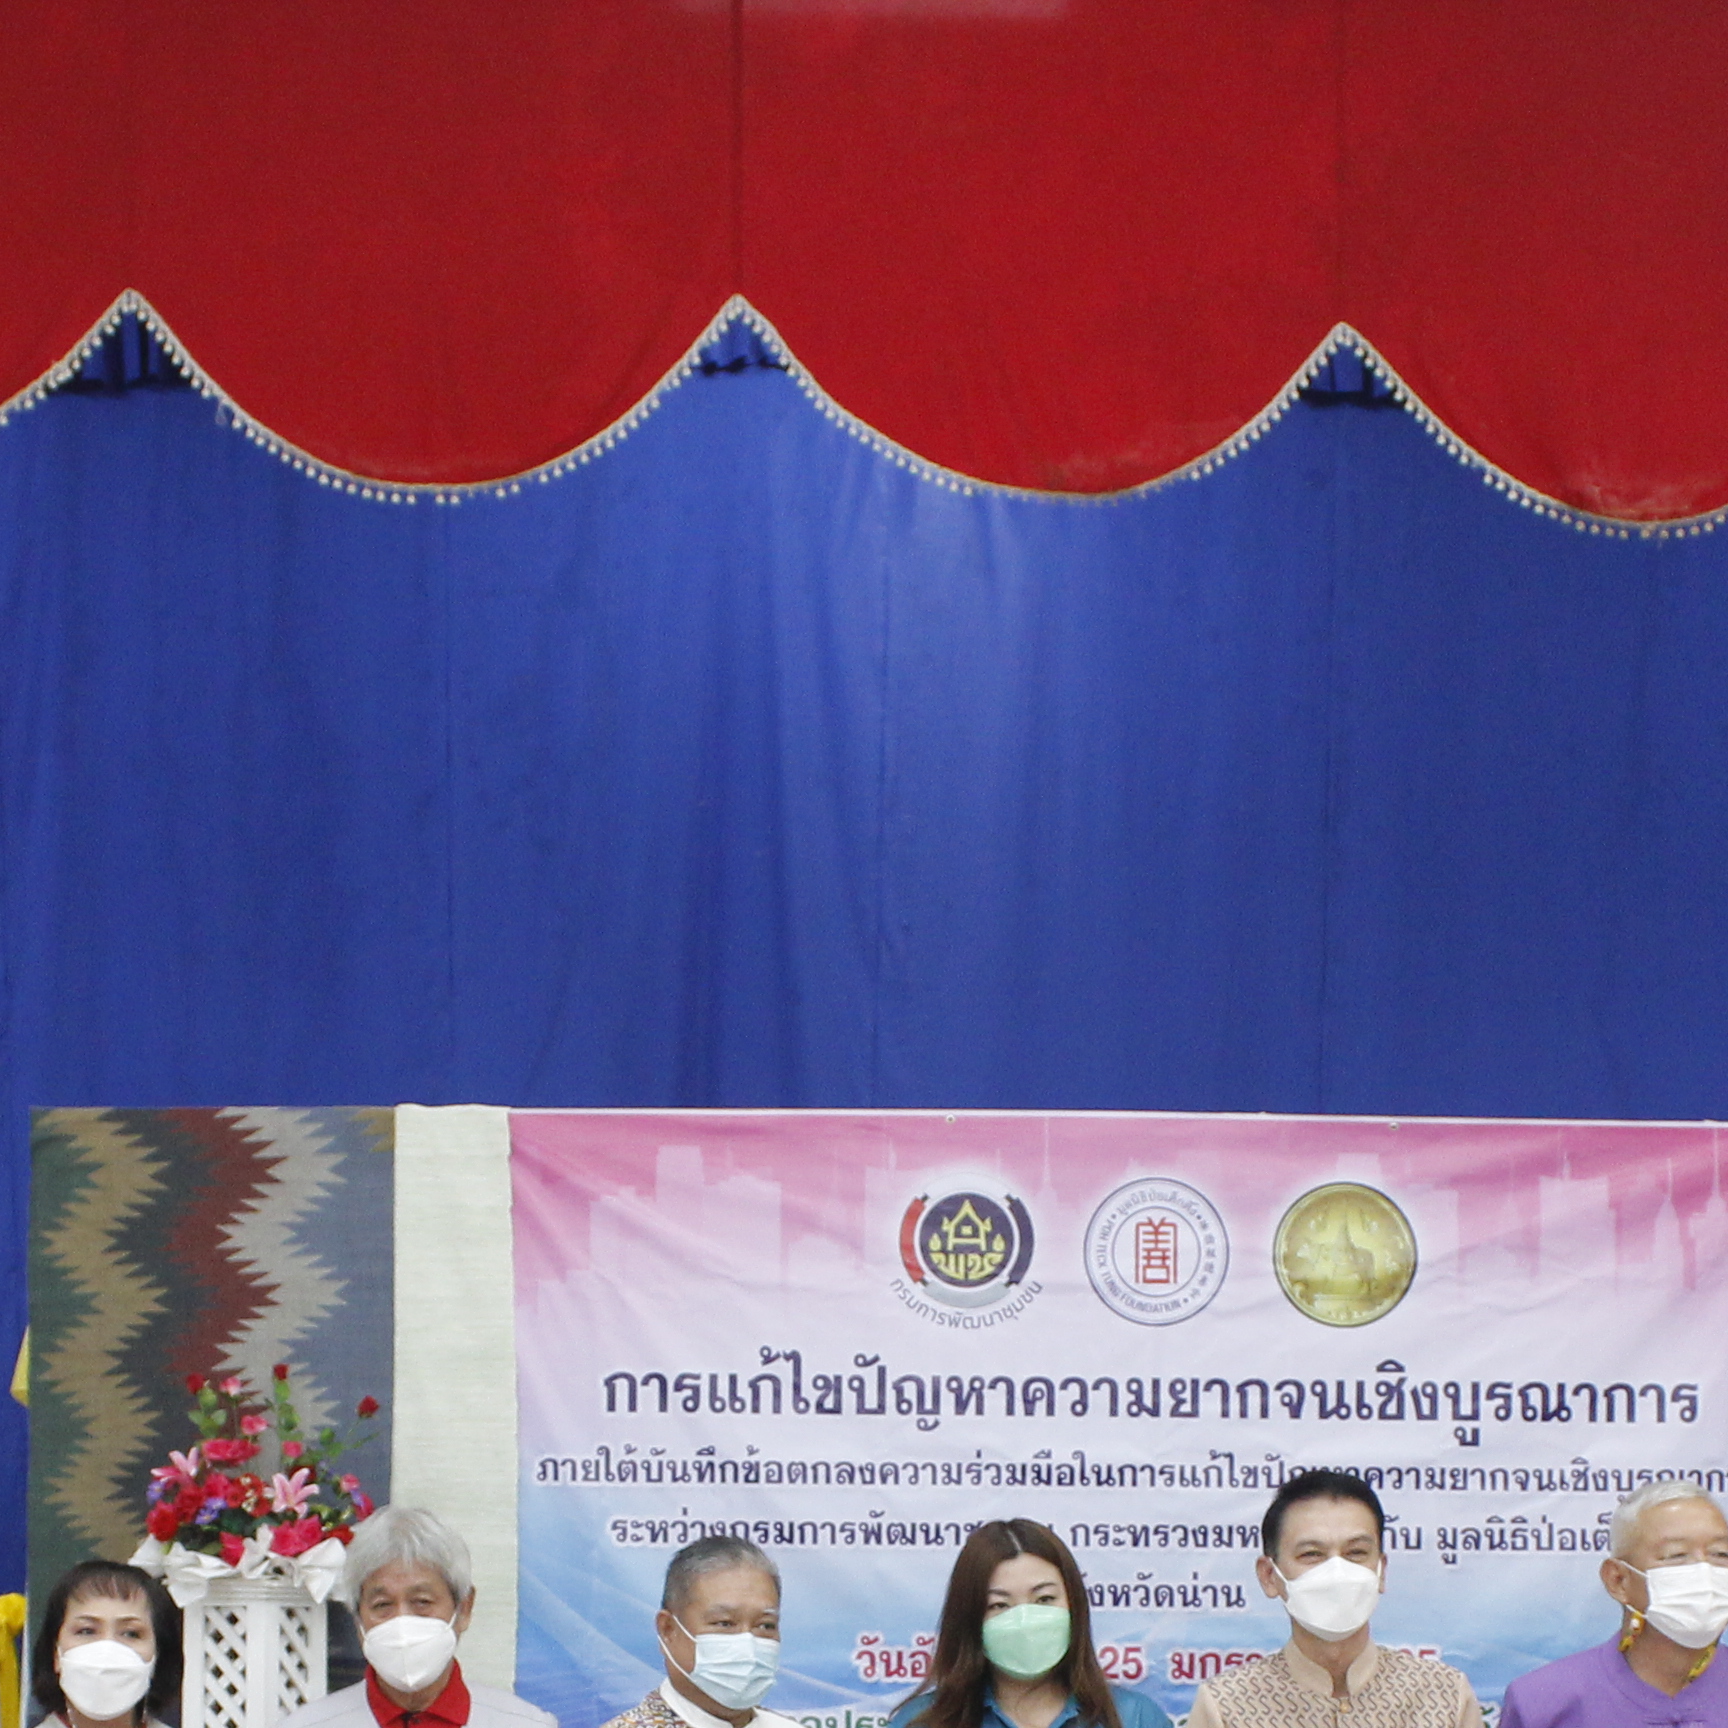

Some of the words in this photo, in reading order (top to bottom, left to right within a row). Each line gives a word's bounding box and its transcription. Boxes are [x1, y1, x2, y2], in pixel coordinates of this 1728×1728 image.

[603, 1346, 1700, 1446] การแก้ไขปัญหาความยากจนเชิงบูรณาการ
